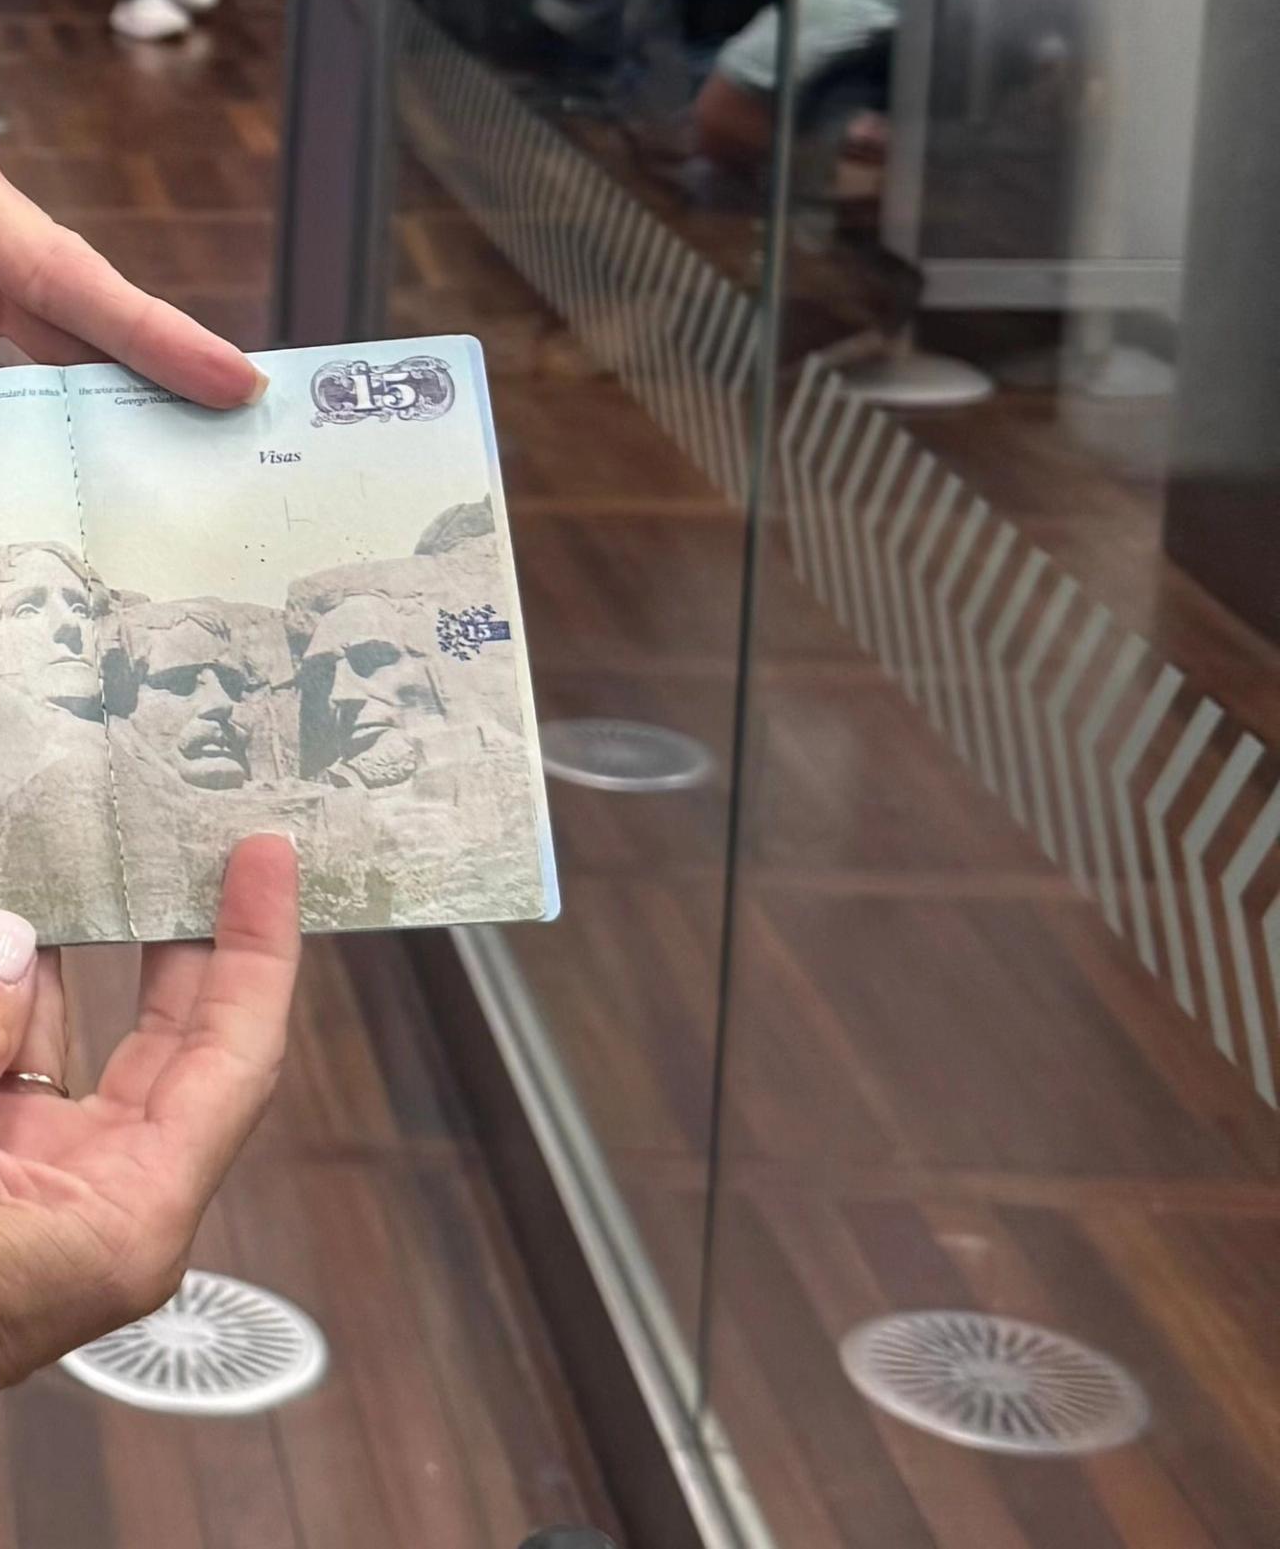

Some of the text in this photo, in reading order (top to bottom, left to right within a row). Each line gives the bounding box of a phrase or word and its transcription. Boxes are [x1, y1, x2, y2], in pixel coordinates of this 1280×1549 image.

[350, 371, 417, 412] 15
[259, 451, 302, 464] Visas
[467, 624, 491, 639] 15
